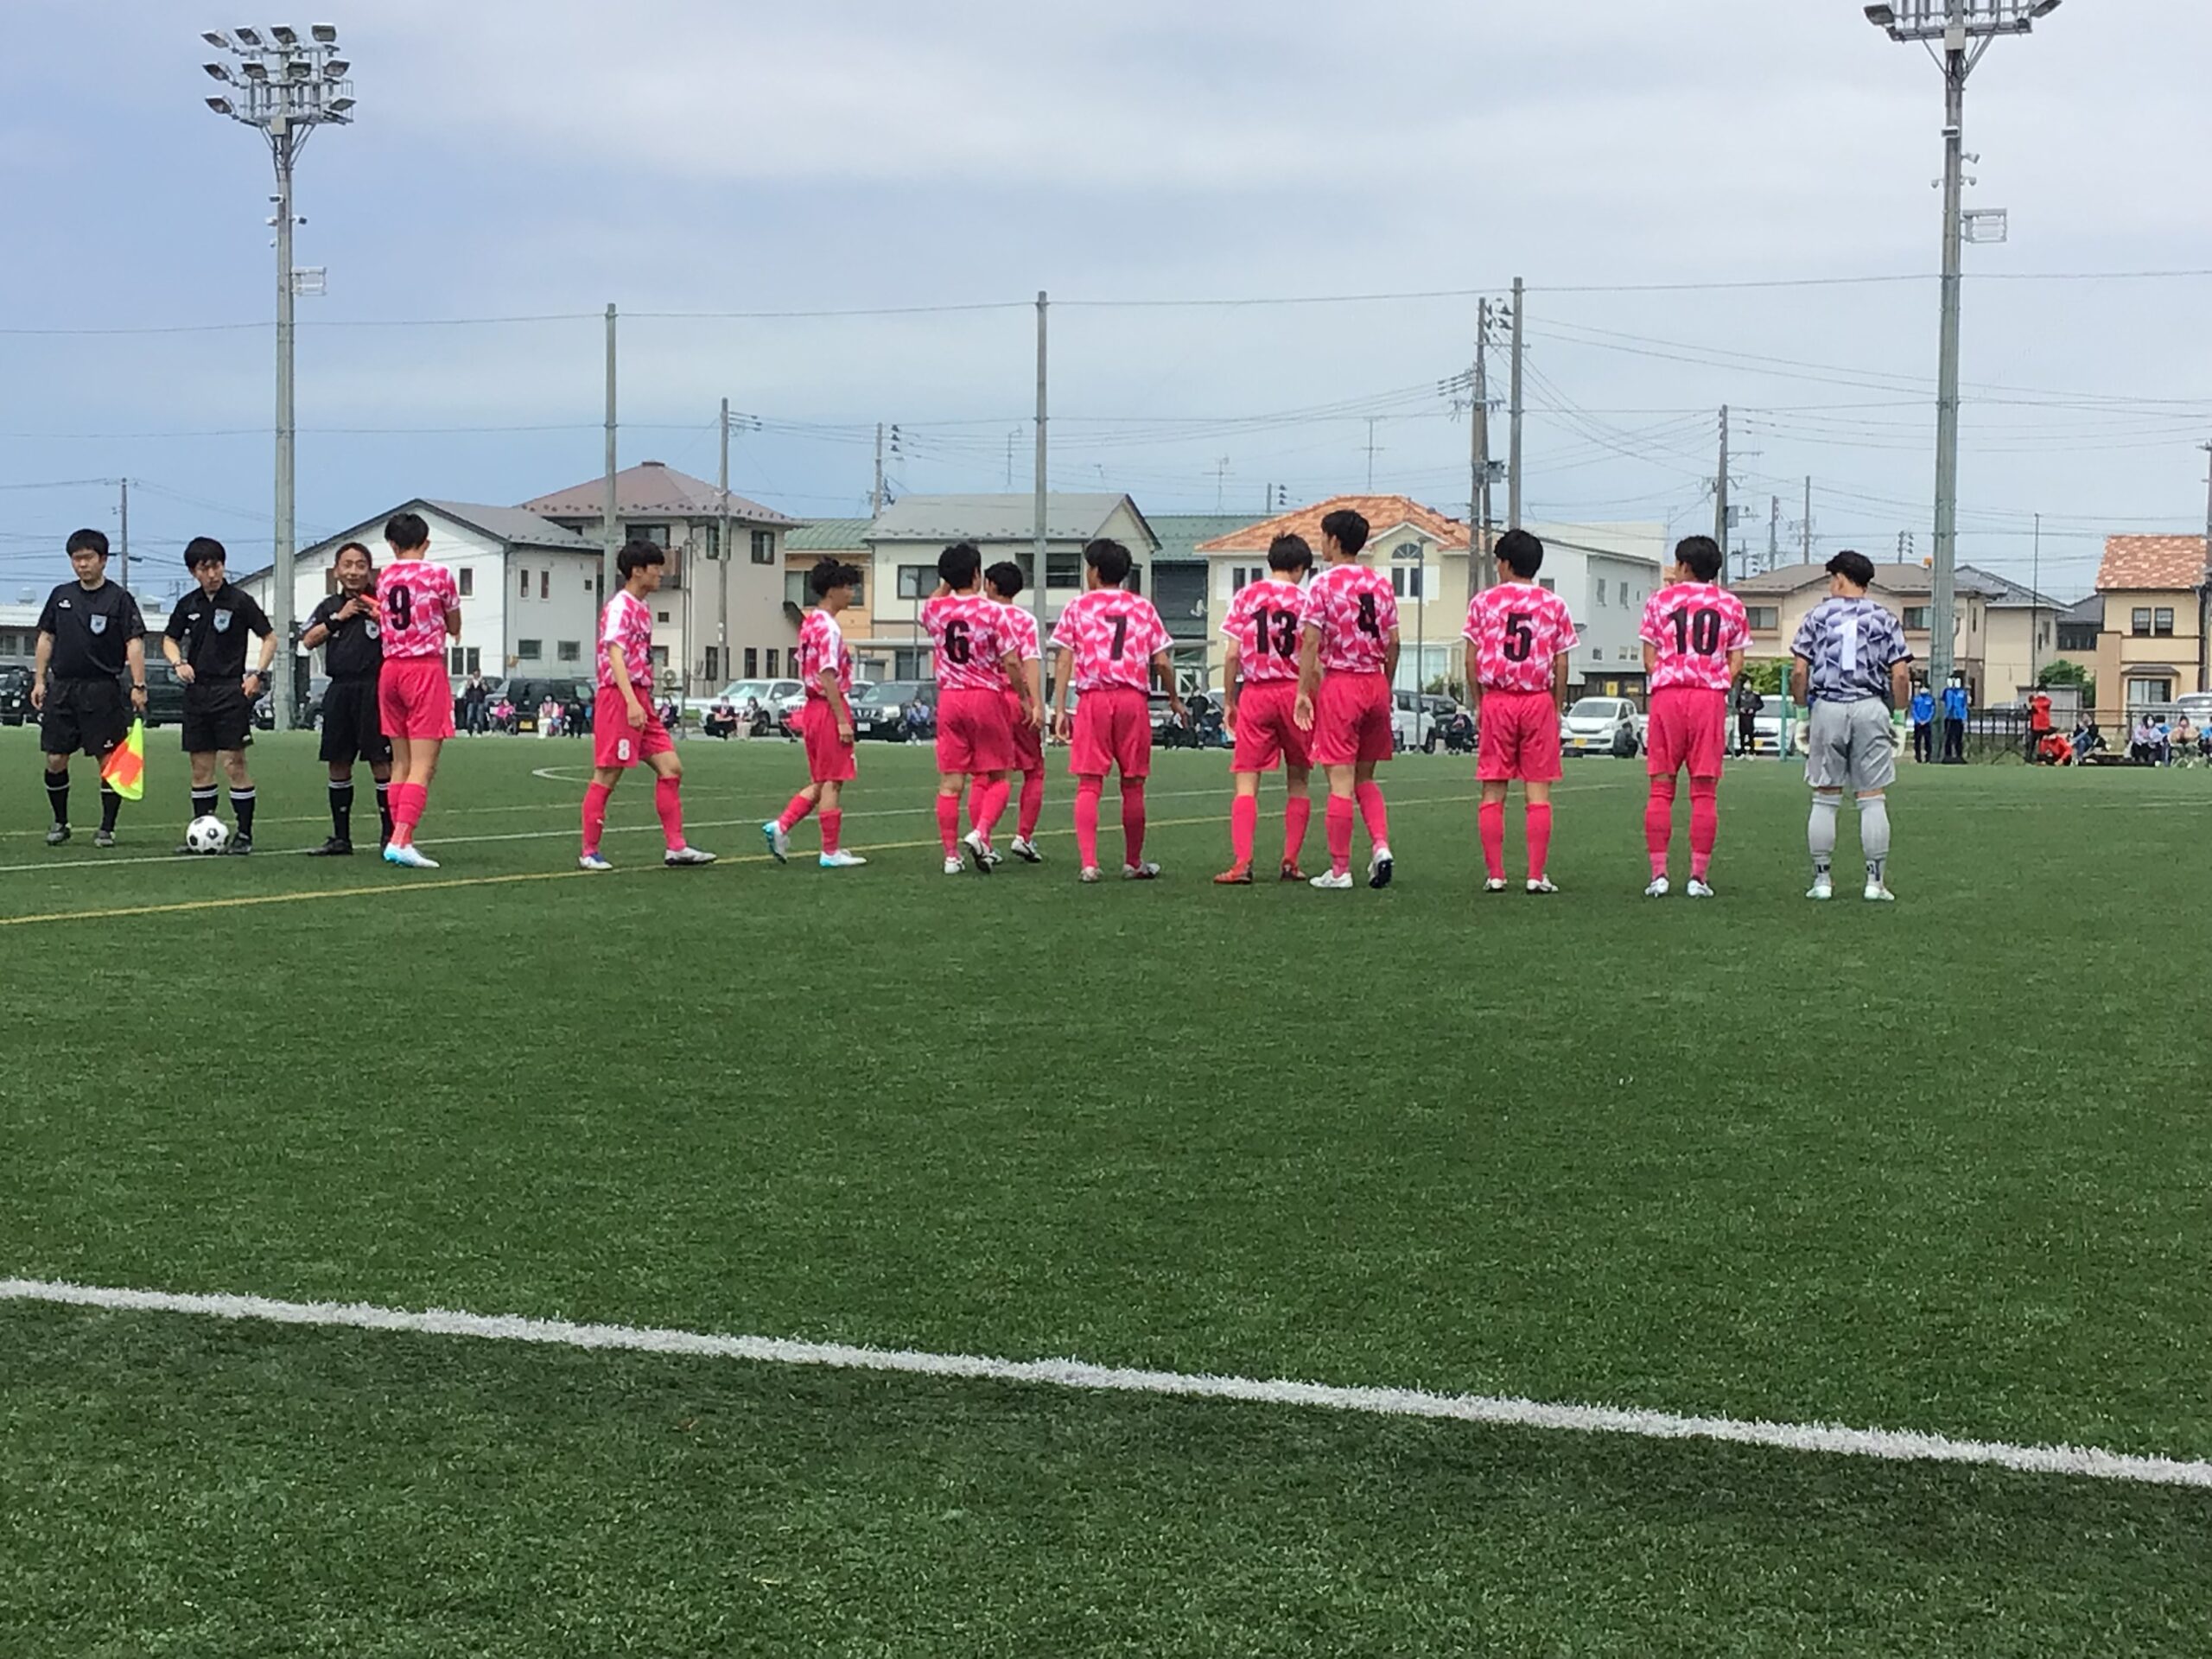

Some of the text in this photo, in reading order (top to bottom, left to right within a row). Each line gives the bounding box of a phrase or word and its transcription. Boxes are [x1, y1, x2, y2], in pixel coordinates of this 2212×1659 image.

[388, 584, 411, 631] 9
[1357, 593, 1381, 639] 4
[1668, 606, 1721, 656] 10
[944, 620, 971, 664] 6
[1104, 614, 1128, 661] 7
[1251, 606, 1297, 658] 13
[1503, 612, 1533, 663] 5
[1833, 618, 1858, 671] 1
